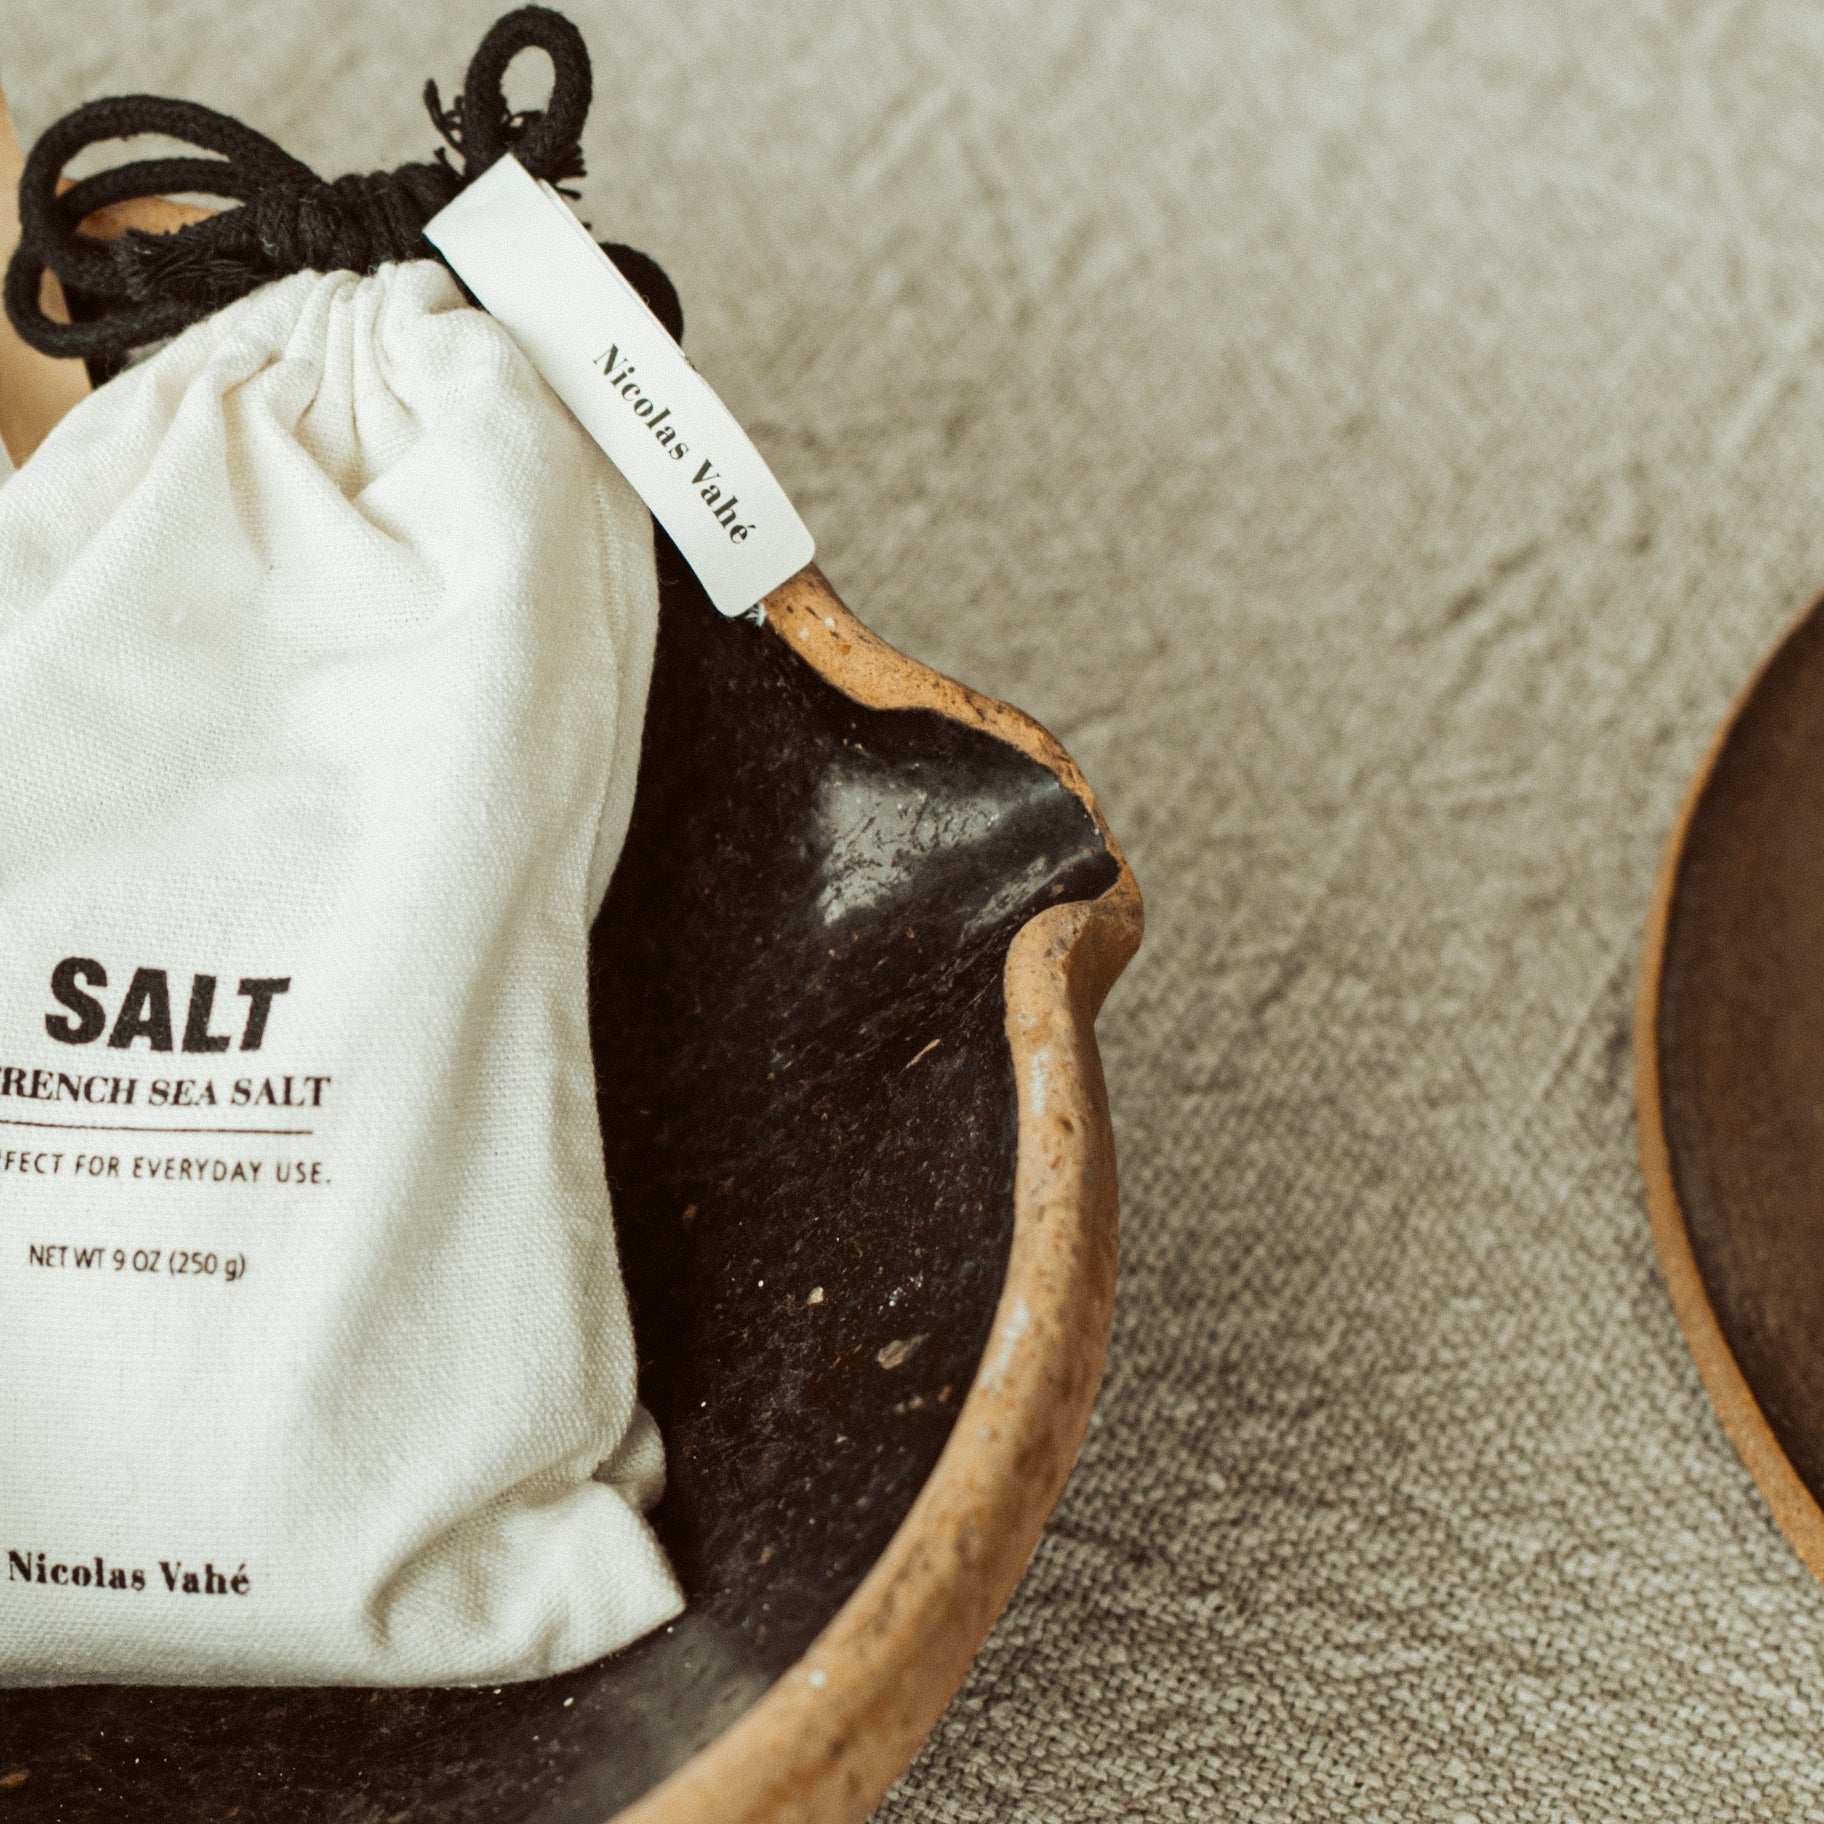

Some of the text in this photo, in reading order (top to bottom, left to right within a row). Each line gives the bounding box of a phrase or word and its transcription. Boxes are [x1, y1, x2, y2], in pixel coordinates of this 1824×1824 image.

[592, 343, 757, 544] Nicolas Vahé
[45, 956, 292, 1053] SALT
[148, 1078, 217, 1108] SEA
[230, 1076, 331, 1107] SALT
[75, 1153, 119, 1178] FOR
[133, 1156, 263, 1184] EVERYDAY
[276, 1161, 332, 1185] USE.
[28, 1244, 247, 1282] NET WT 9 OZ (250 g)
[7, 1549, 251, 1595] Nicolas Vahé
